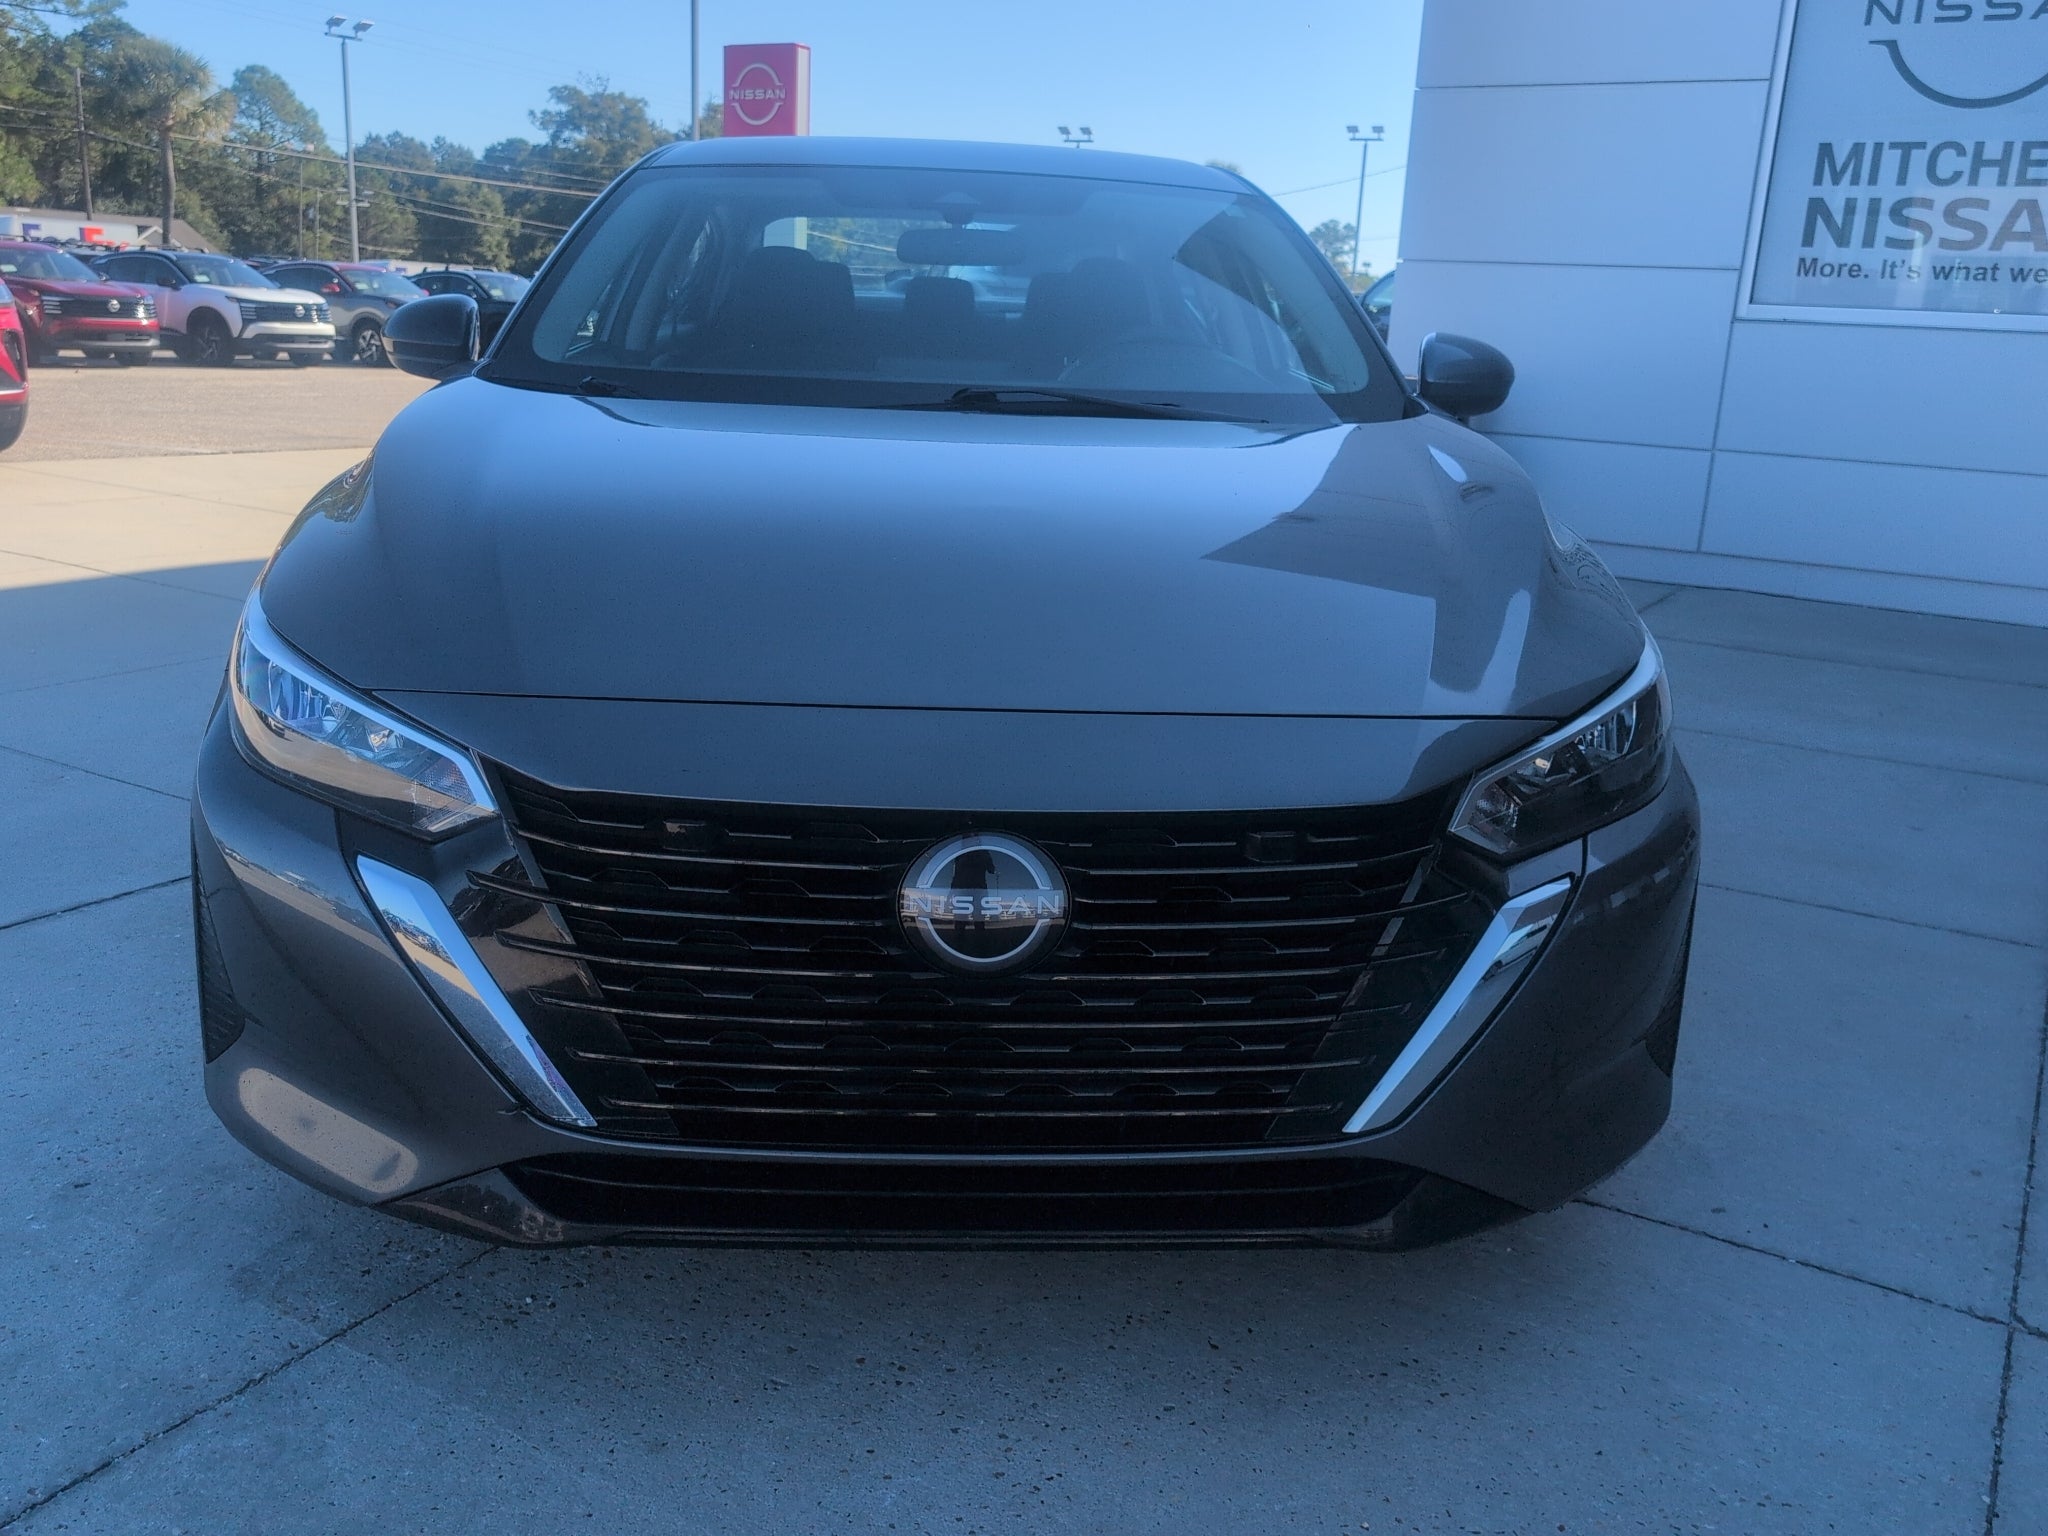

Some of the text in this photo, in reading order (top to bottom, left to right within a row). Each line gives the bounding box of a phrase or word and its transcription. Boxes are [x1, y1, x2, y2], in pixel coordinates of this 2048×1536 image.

[729, 89, 785, 100] NISSAN
[1812, 141, 2048, 187] MITCHE
[1800, 197, 2048, 252] NISSA
[1796, 257, 1869, 279] More.
[1880, 259, 1921, 281] It's
[1932, 262, 2000, 281] what
[908, 895, 1060, 915] NISSAN
